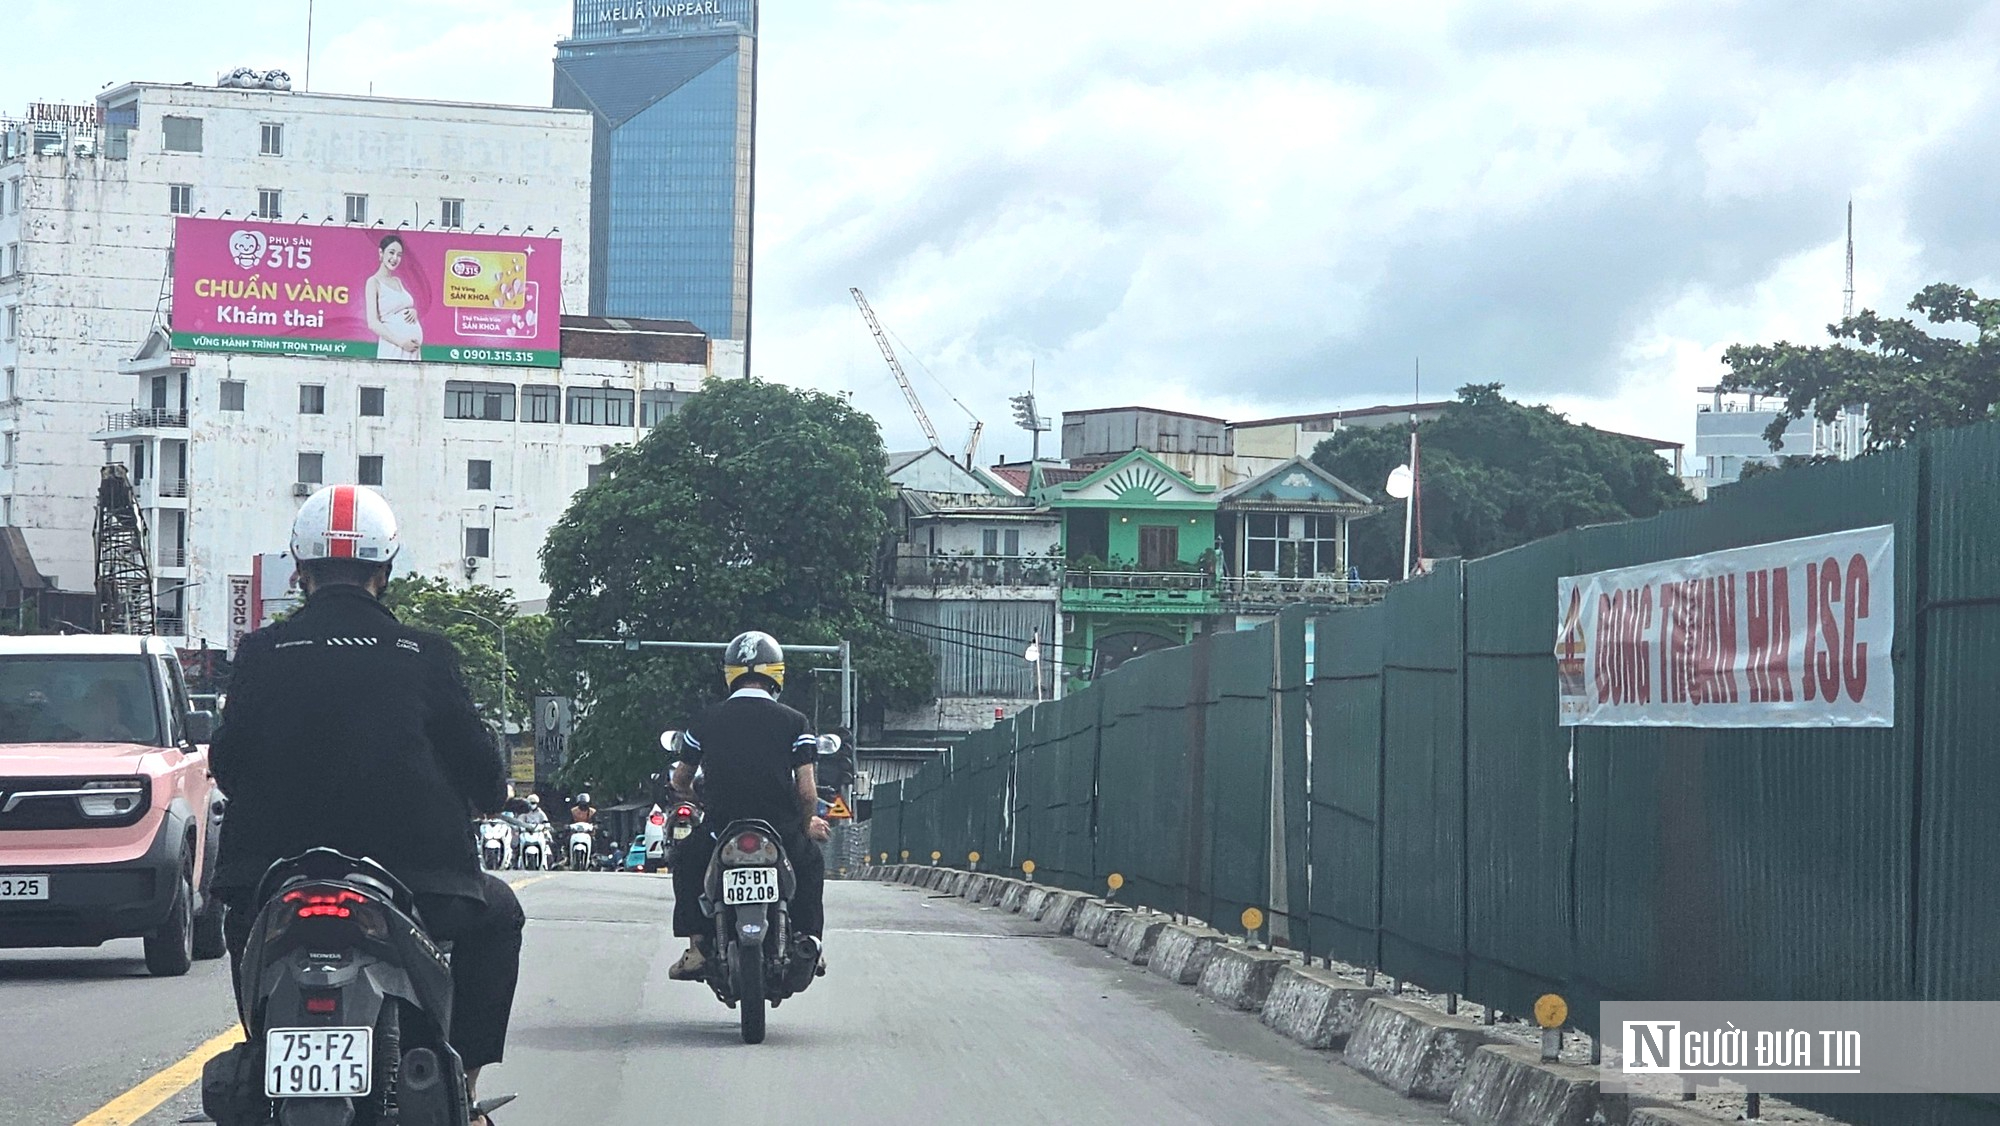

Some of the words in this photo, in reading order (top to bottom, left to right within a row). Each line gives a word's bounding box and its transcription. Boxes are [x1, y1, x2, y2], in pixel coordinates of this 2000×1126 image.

[652, 0, 720, 18] VINPEARL
[28, 103, 70, 122] THANH
[73, 103, 105, 122] UYÊ
[269, 236, 289, 246] PHỤ
[292, 235, 312, 246] SẢN
[267, 245, 312, 269] 315
[465, 267, 478, 275] 315
[194, 274, 278, 300] CHUẨN
[284, 278, 349, 304] VÀNG
[450, 291, 466, 300] SẢN
[468, 293, 490, 301] KHOA
[217, 305, 277, 325] Khám
[283, 309, 324, 328] thai
[479, 322, 501, 331] KHOA
[192, 336, 220, 347] VỮNG
[221, 337, 249, 348] HÀNH
[252, 339, 280, 349] TRÌNH
[282, 341, 308, 352] TRỌN
[310, 343, 332, 352] THAI
[463, 349, 534, 362] 0901.315.315
[1746, 566, 1794, 703] HA
[1802, 553, 1869, 704] JSC
[731, 870, 768, 886] 75-B1
[0, 880, 39, 896] 3.25
[282, 1033, 355, 1062] 75-F2
[272, 1064, 364, 1093] 190.15
